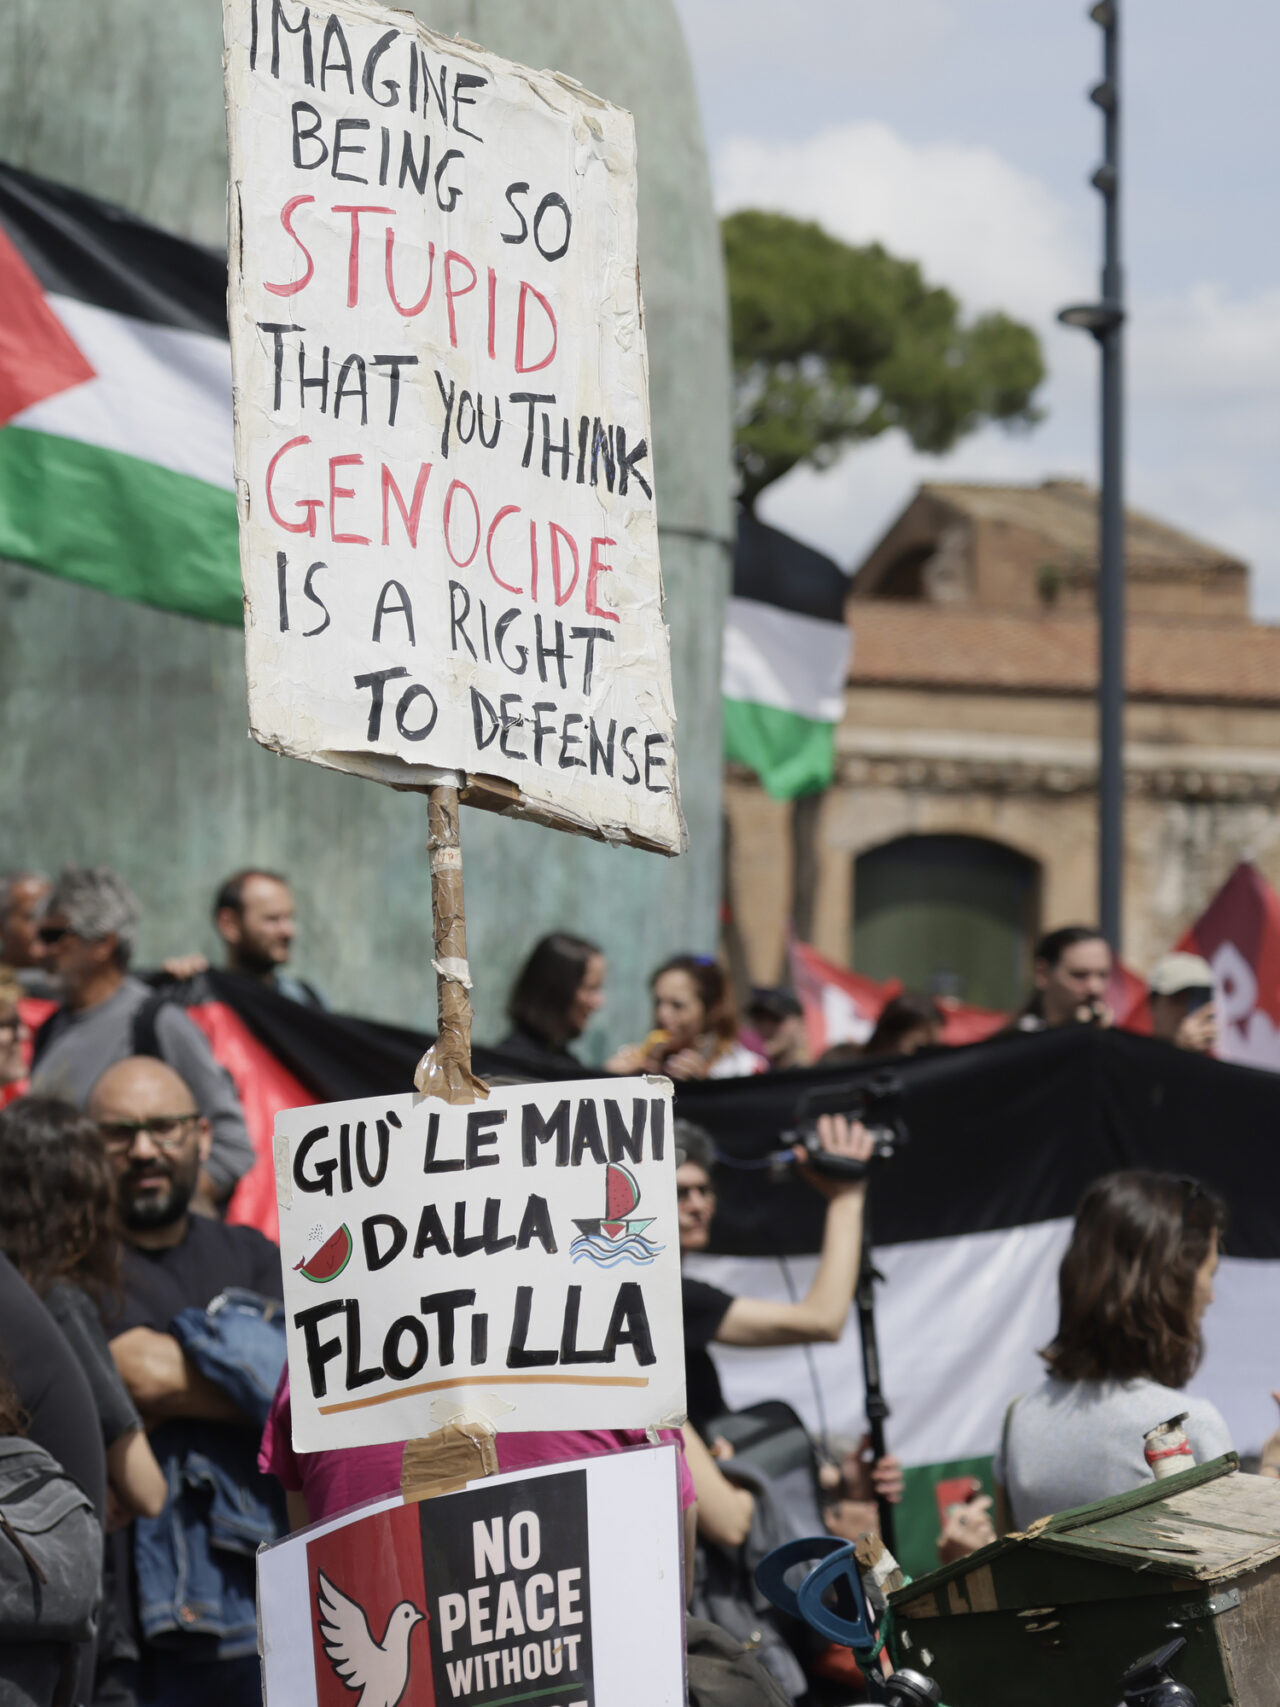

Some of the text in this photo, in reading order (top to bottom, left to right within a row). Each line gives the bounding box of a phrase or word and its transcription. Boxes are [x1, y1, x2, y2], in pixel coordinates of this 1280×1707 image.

[250, 0, 488, 143] IMAGINE
[291, 101, 572, 261] BEING SO
[263, 195, 558, 374] STUPID
[256, 323, 653, 500] THAT YOU THINK
[265, 435, 620, 623] GENOCIDE
[277, 551, 615, 696] IS A RIGHT
[354, 666, 672, 793] TO DEFENSE
[423, 1109, 508, 1174] LE
[521, 1098, 666, 1167] MANI
[362, 1193, 558, 1271] DALLA
[294, 1282, 657, 1398] FLOTILLA
[472, 1510, 541, 1580] NO
[438, 1567, 584, 1653] PEACE
[445, 1634, 582, 1698] WITHOUT
